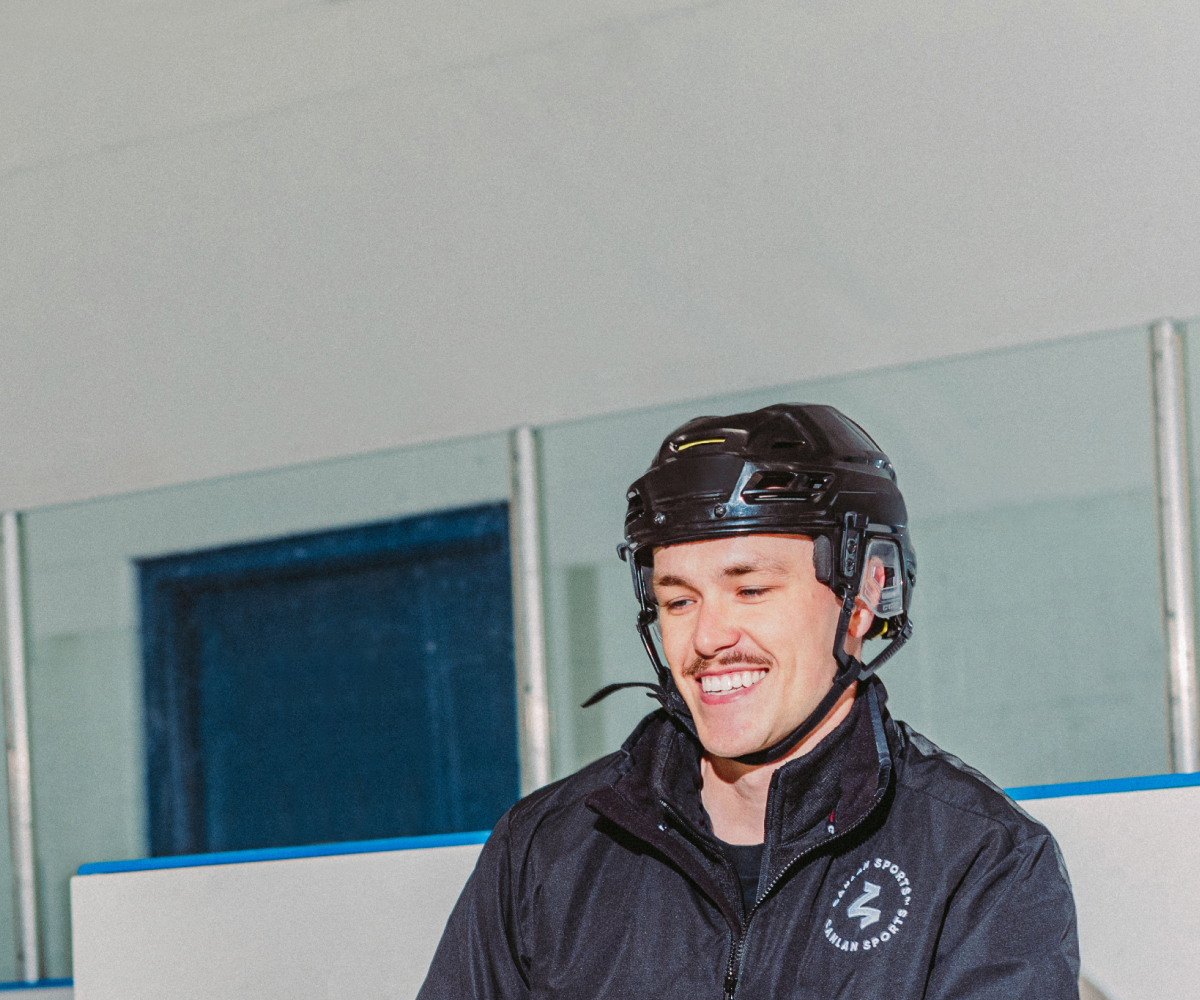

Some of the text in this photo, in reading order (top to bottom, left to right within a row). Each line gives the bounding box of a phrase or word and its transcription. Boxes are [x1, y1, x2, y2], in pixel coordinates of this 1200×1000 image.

[873, 857, 913, 896] SPORTS
[823, 908, 909, 952] CANLAN SPORTS
